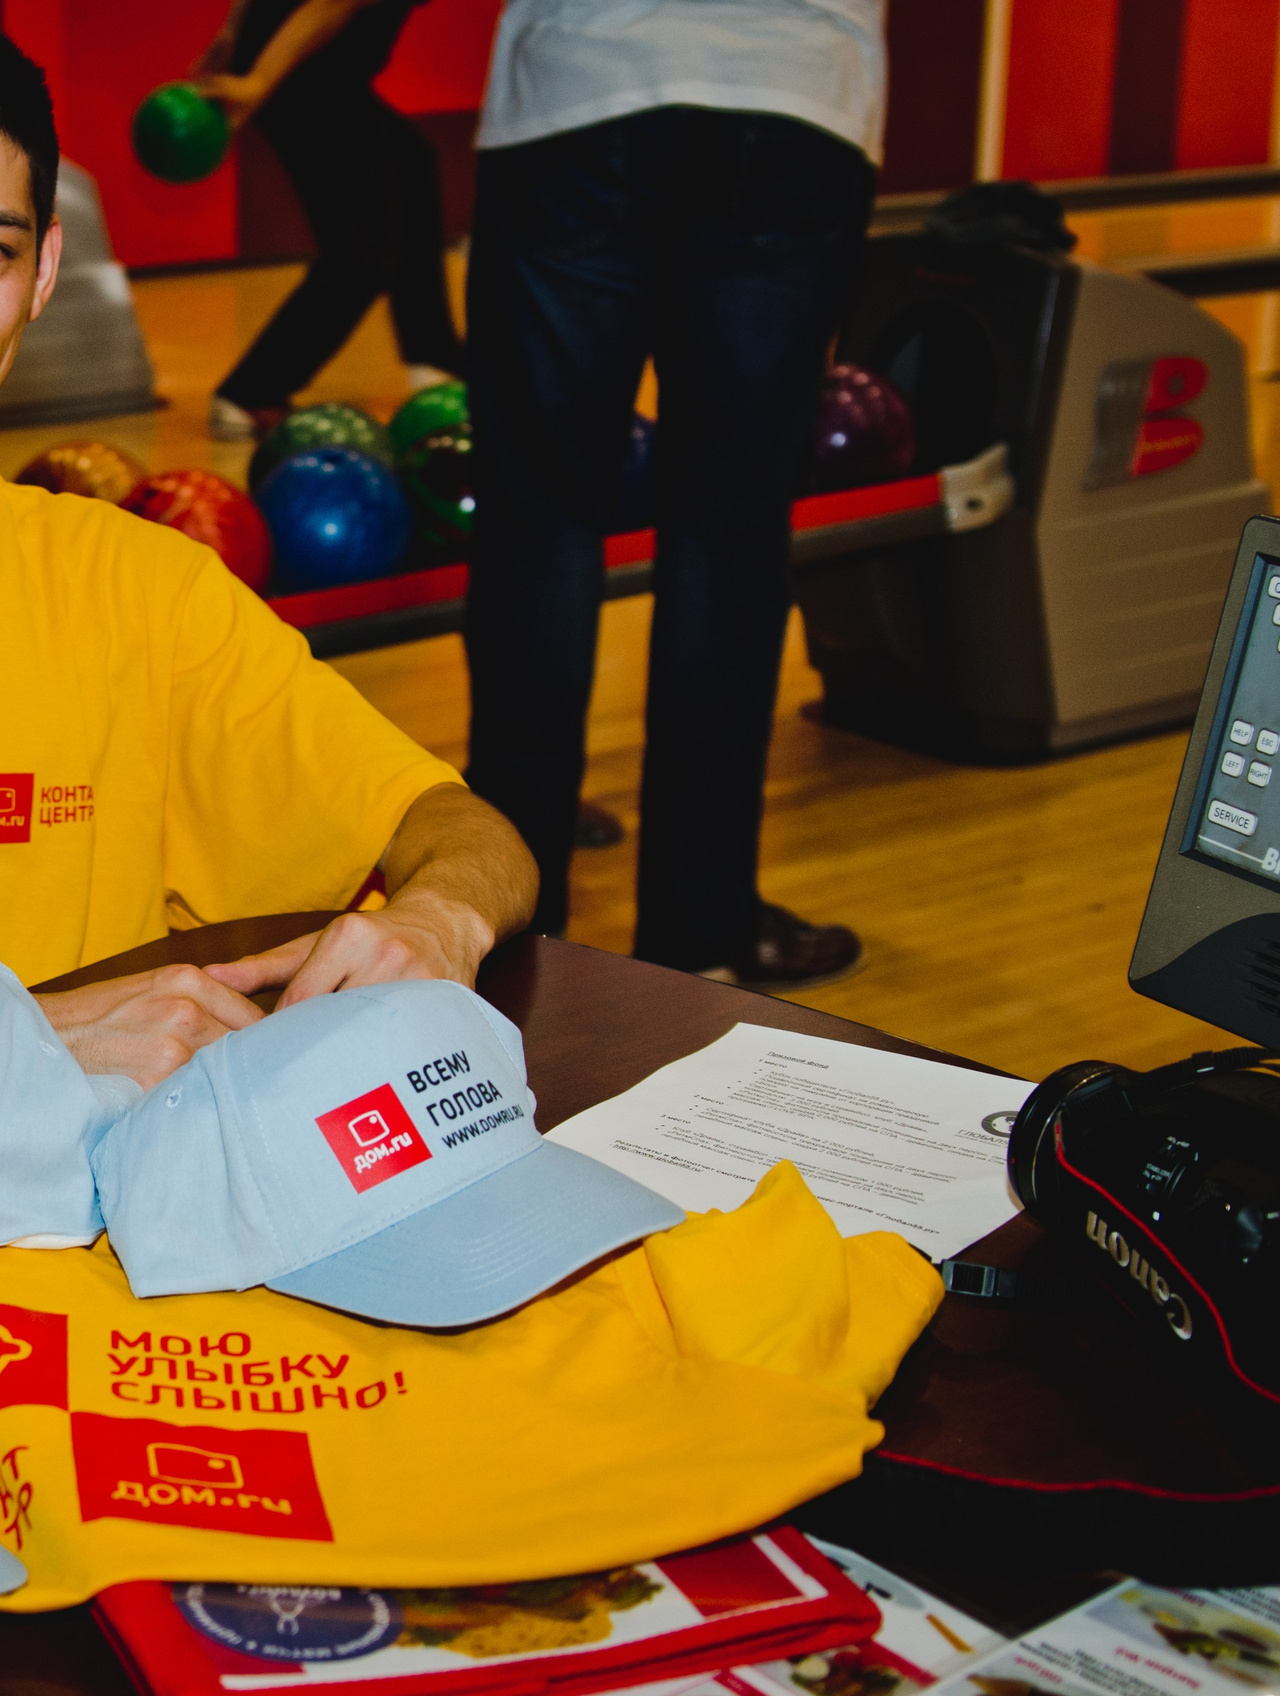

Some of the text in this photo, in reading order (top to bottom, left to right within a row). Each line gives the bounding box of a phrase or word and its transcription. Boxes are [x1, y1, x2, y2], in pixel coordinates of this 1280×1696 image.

[40, 785, 94, 804] КОНТА
[1213, 807, 1251, 830] SERVICE
[406, 1050, 470, 1094] ВСЕМУ
[426, 1079, 503, 1127] ГОЛОВА
[441, 1104, 525, 1150] WWW.DOMRU.RU
[1086, 1209, 1193, 1341] Canon
[110, 1329, 252, 1358] МОЮ
[106, 1352, 350, 1386] УЛЫБКУ
[110, 1371, 408, 1414] СЛЫШНО!
